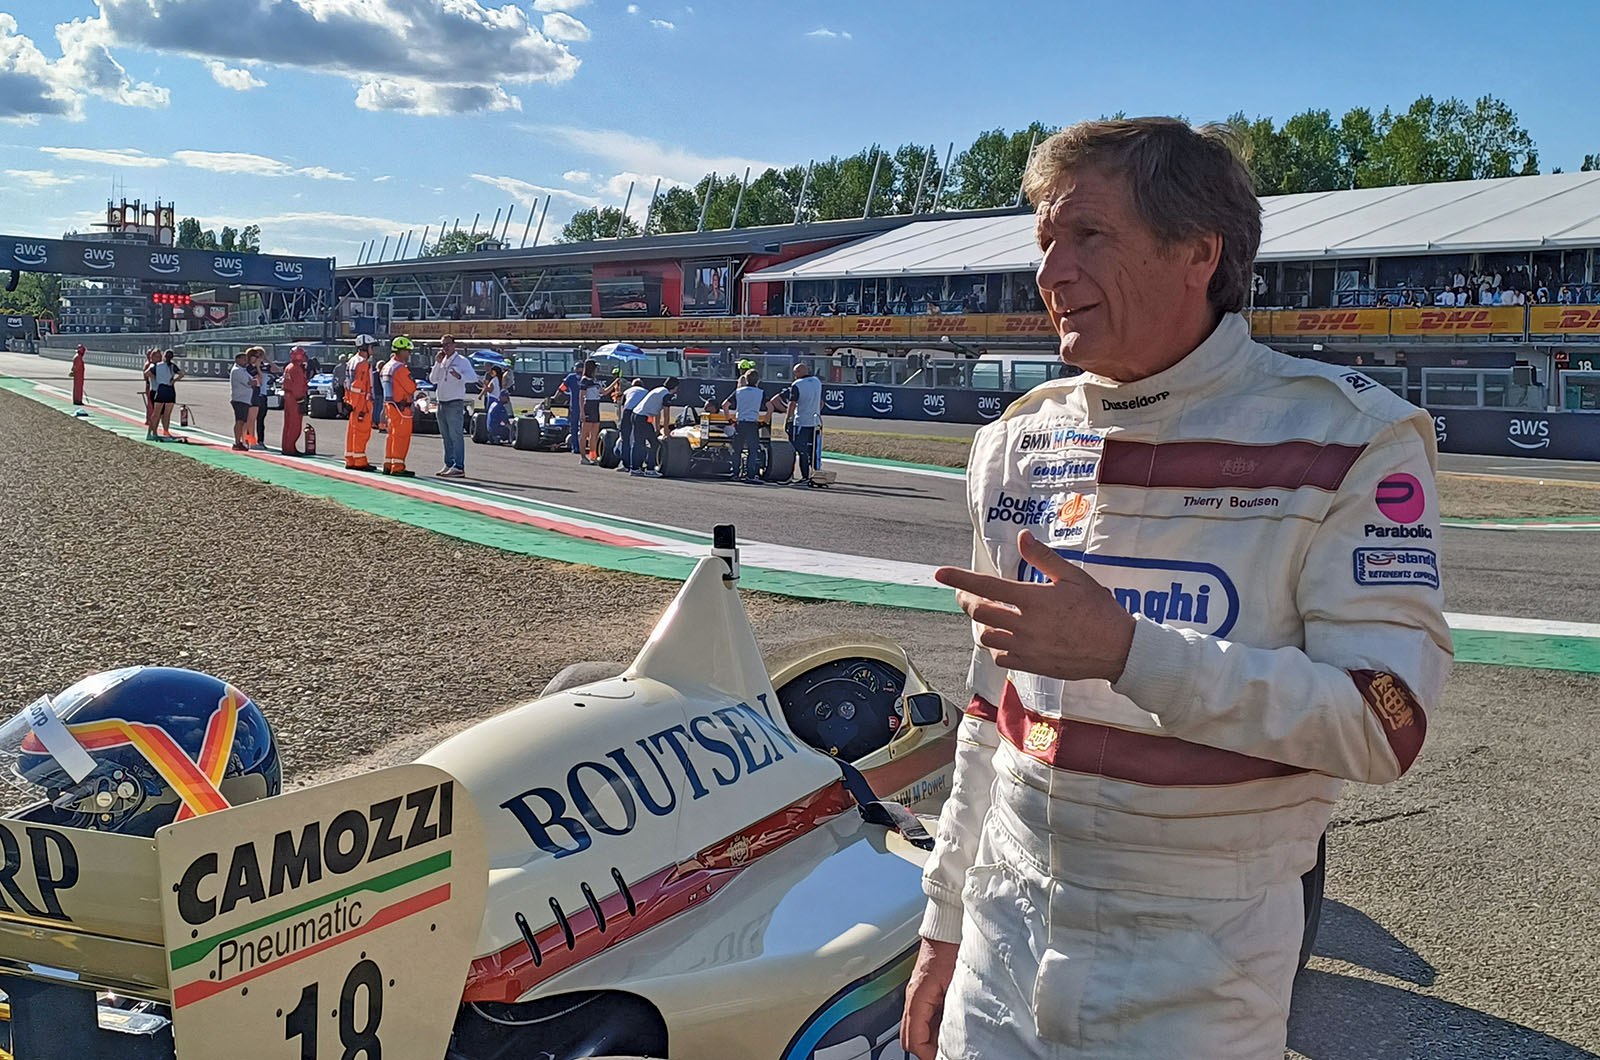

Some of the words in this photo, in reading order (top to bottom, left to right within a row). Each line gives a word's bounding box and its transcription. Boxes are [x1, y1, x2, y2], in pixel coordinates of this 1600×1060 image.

[14, 243, 47, 257] aws
[84, 248, 114, 261] aws
[150, 252, 180, 266] aws
[213, 257, 242, 270] aws
[275, 261, 303, 274] aws
[855, 318, 894, 332] DHL
[926, 317, 968, 332] DHL
[1005, 317, 1051, 332] DHL
[1296, 312, 1362, 331] DHL
[1418, 310, 1493, 330] DHL
[1577, 360, 1593, 371] 18
[699, 383, 716, 396] aws
[825, 389, 845, 402] aws
[871, 391, 893, 404] aws
[923, 393, 945, 407] aws
[978, 396, 1001, 410] aws
[1509, 418, 1550, 436] aws
[1020, 434, 1052, 451] BMW
[1053, 430, 1065, 450] M
[1065, 429, 1105, 447] Power
[1183, 496, 1223, 509] Thierry
[1229, 495, 1279, 508] Boutsen
[499, 692, 799, 859] BOUTSEN
[921, 774, 947, 800] Power
[177, 780, 454, 926] CAMOZZI
[217, 897, 363, 981] Pneumatic
[285, 959, 383, 1060] 18
